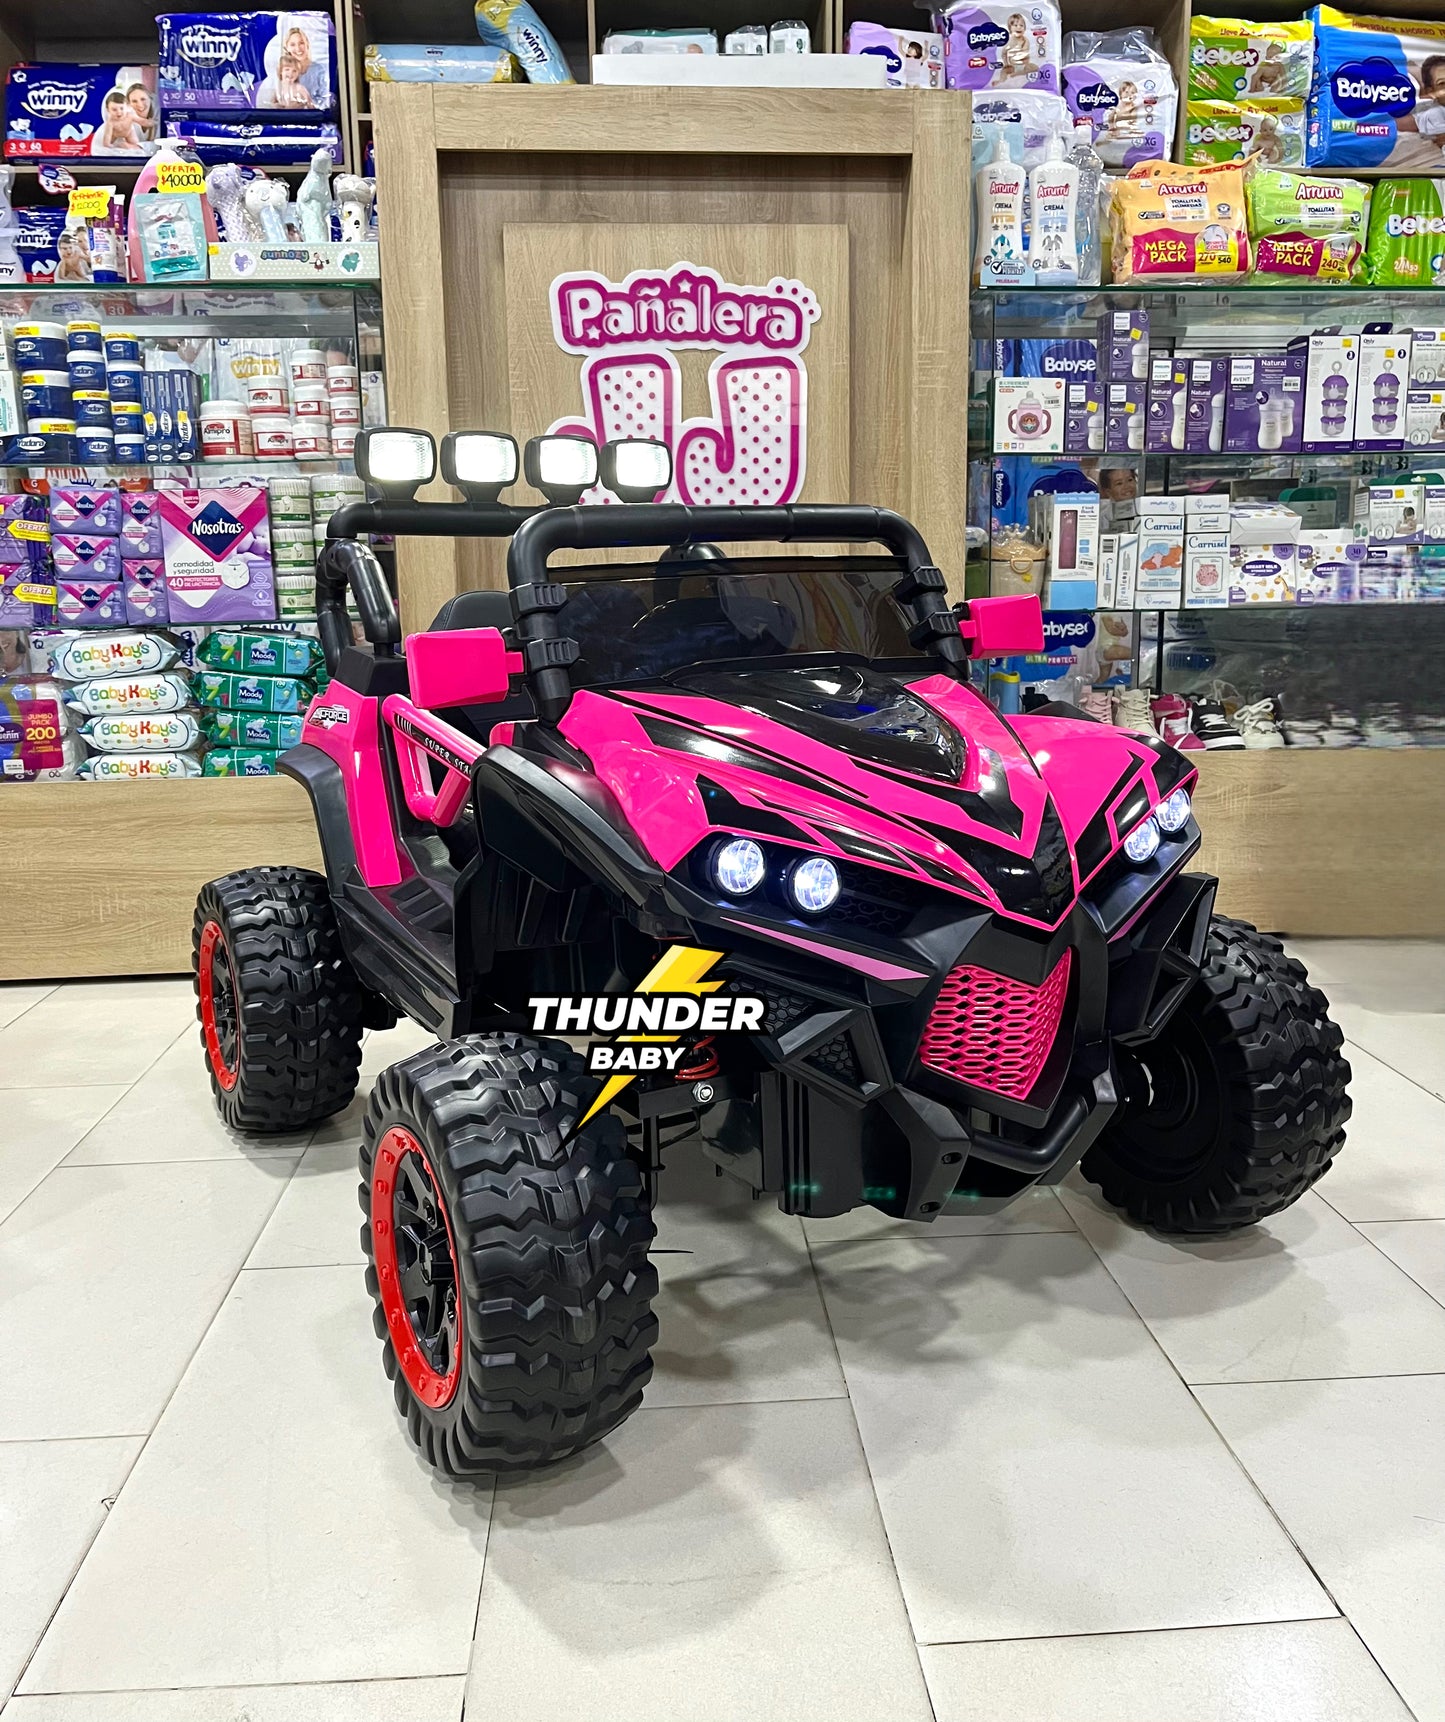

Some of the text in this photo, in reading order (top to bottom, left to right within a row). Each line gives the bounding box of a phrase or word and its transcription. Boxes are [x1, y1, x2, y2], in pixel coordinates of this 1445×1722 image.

[969, 32, 1006, 44] Babysec
[186, 35, 239, 58] winny
[523, 28, 549, 64] winny
[1193, 45, 1258, 67] Bebex
[1039, 70, 1051, 79] XG
[1336, 77, 1410, 104] Babysec
[31, 88, 86, 112] winny
[1079, 93, 1116, 107] Babysec
[1189, 124, 1252, 144] Bebex
[1145, 137, 1157, 146] XG
[1158, 182, 1208, 196] Arrurrú
[1145, 241, 1188, 251] MEGA
[1273, 241, 1315, 253] MEGA
[261, 250, 309, 263] sunnozy
[1151, 251, 1188, 262] PACK
[1276, 252, 1312, 267] PACK
[1321, 258, 1338, 269] 240
[563, 283, 798, 343] Pañalera
[1045, 356, 1097, 374] Babyse
[16, 522, 48, 532] OFERTA
[190, 518, 241, 535] Nosotras
[1144, 517, 1183, 530] Carrusel
[1189, 535, 1228, 548] Carrusel
[177, 567, 215, 575] seguridad
[169, 577, 184, 587] 40
[22, 586, 53, 596] OFERTA
[1043, 620, 1089, 638] abysec
[72, 641, 150, 666] Baby Kay's
[252, 651, 275, 661] Moody
[1048, 656, 1077, 664] PROTECT
[90, 684, 167, 703] Baby Kay's
[239, 689, 262, 699] Moody
[26, 727, 56, 741] 200
[101, 721, 178, 738] Baby Kay's
[246, 730, 270, 740] Moody
[423, 737, 452, 764] SUPER
[101, 759, 178, 777] Baby Kay's
